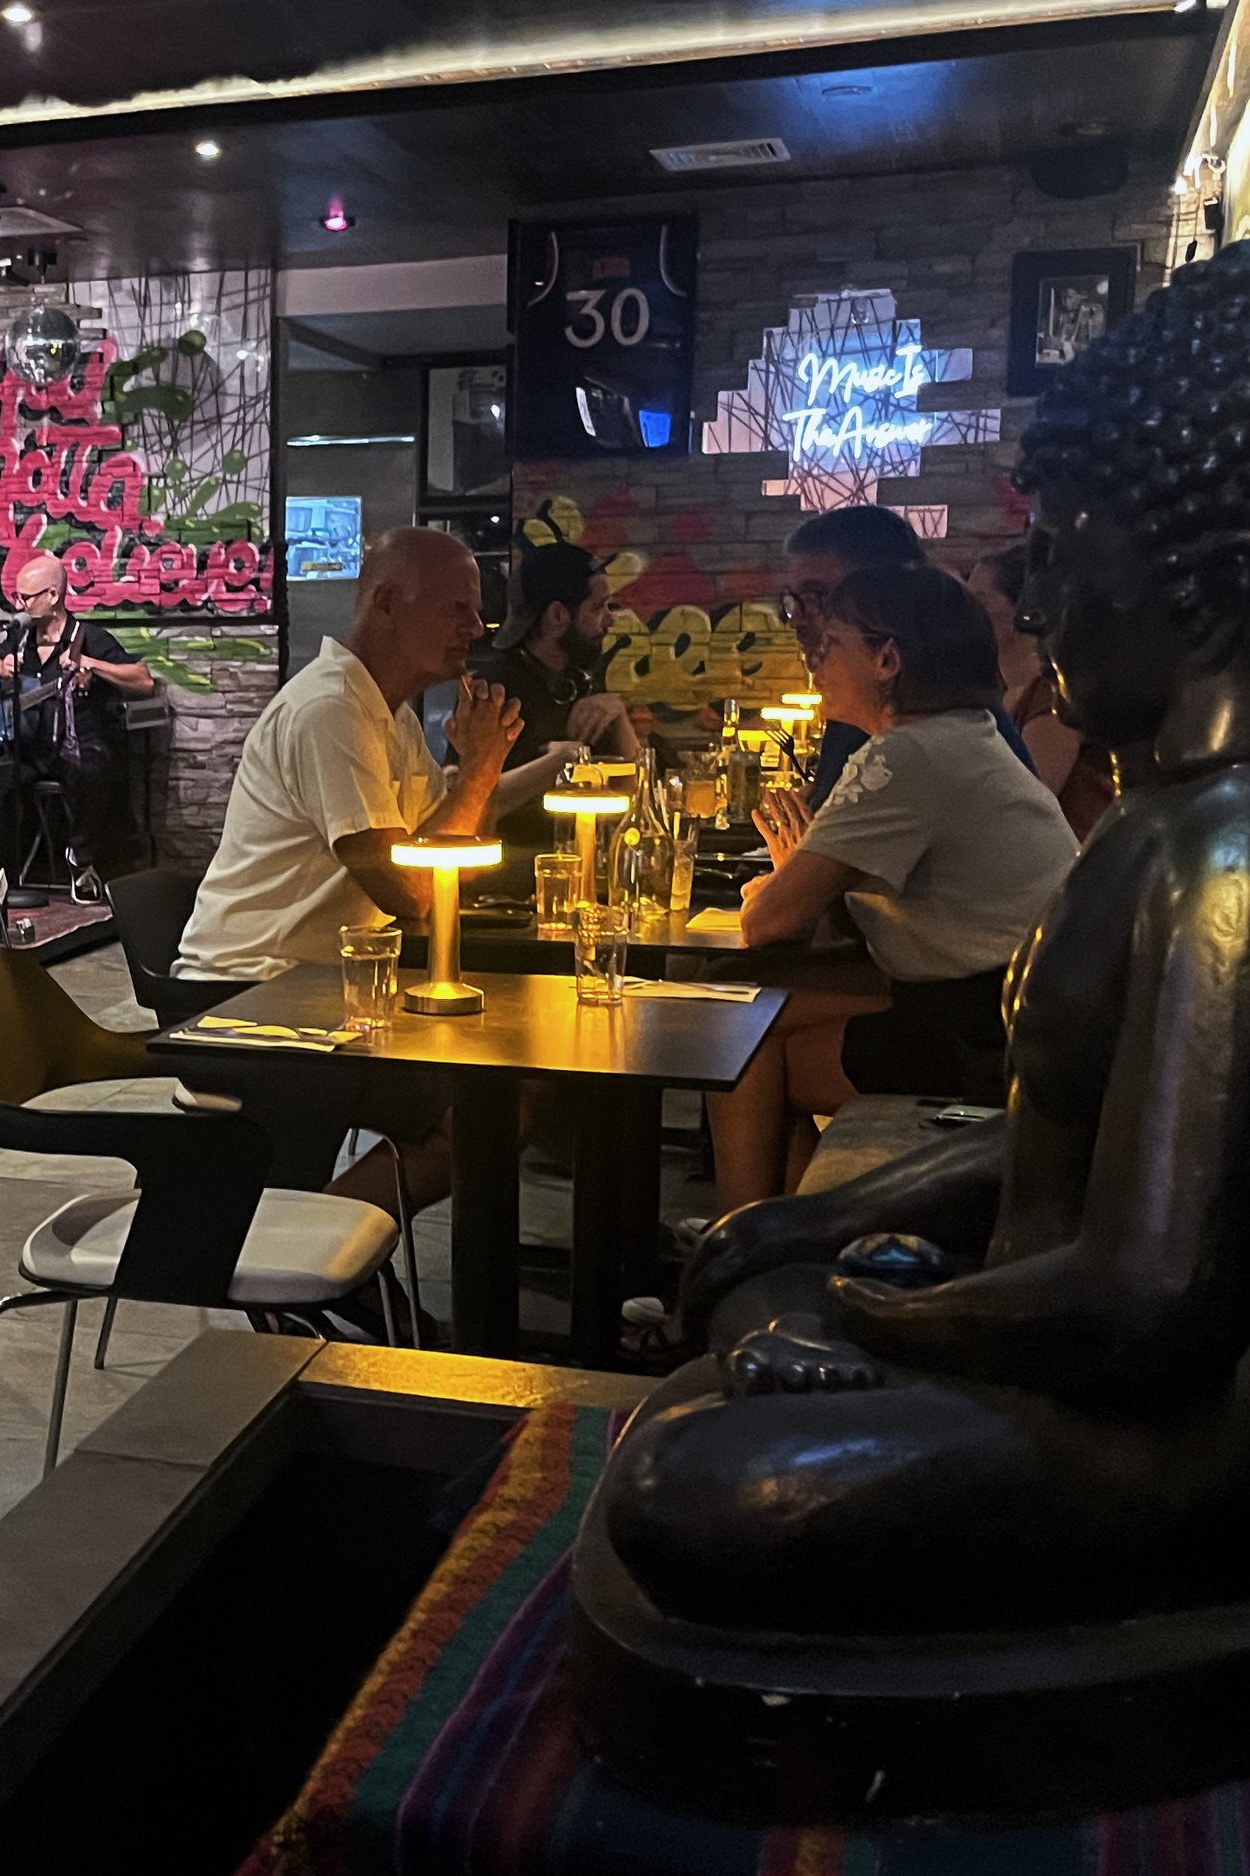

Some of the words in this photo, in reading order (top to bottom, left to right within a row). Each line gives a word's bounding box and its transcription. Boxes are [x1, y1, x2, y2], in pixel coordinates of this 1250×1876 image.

[564, 287, 650, 348] 30
[798, 352, 903, 406] Music
[782, 407, 838, 462] The
[832, 406, 933, 459] Answer
